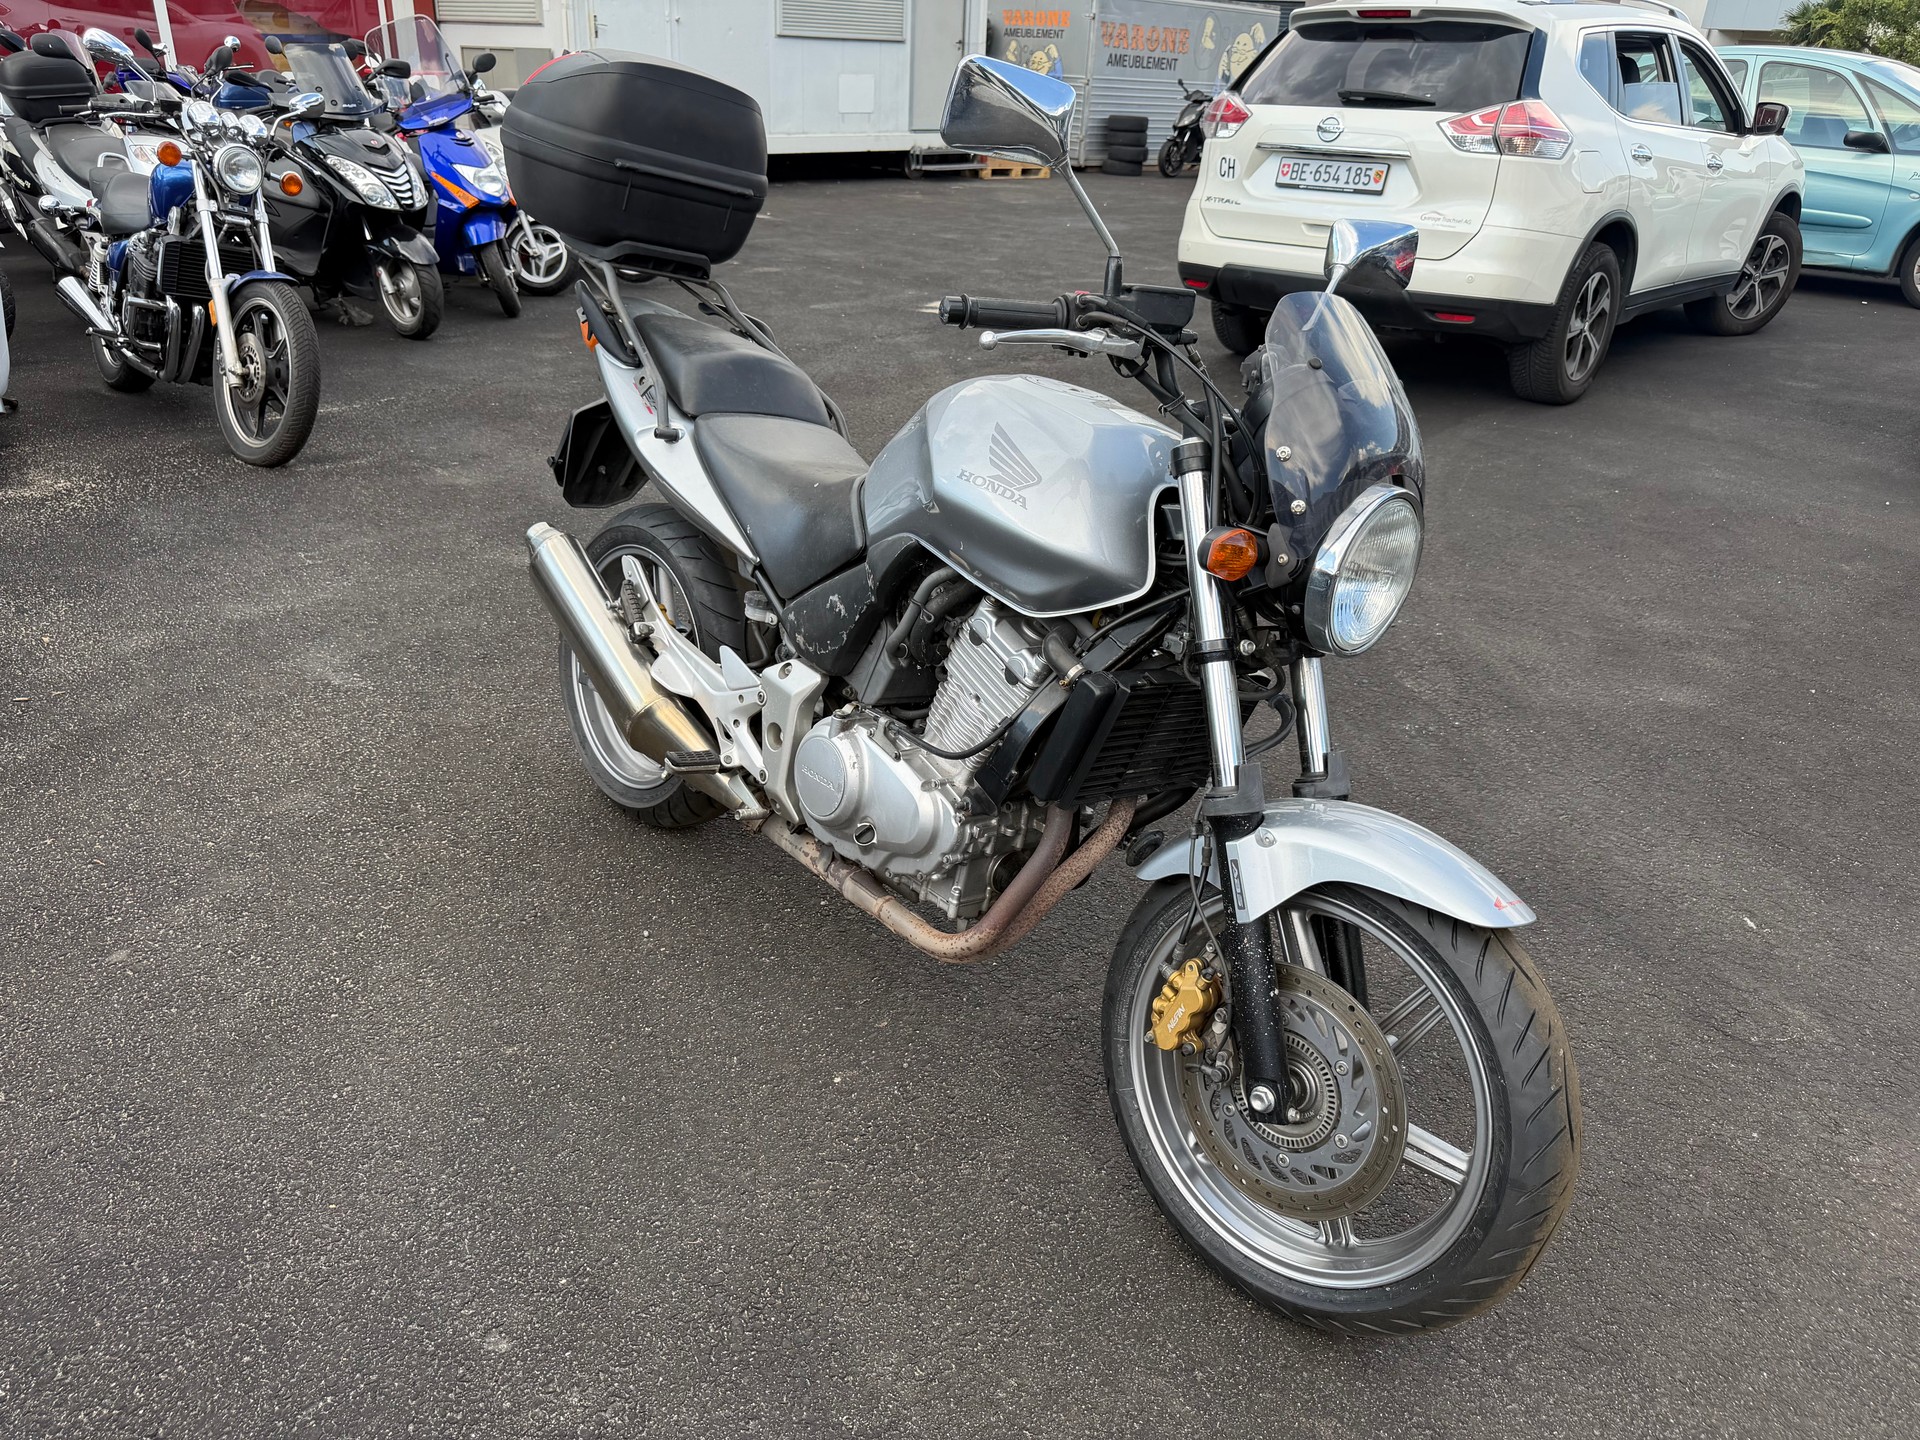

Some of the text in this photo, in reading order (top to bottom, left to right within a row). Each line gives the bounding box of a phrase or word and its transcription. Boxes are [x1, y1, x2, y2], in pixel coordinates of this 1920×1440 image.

[1002, 9, 1071, 27] VARONE
[1003, 28, 1064, 40] AMEUBLEMENT
[1100, 21, 1190, 55] VARONE
[1106, 53, 1179, 72] AMEUBLEMENT
[1219, 156, 1236, 180] CH
[956, 468, 1028, 511] HONDA
[801, 764, 836, 791] HONDA
